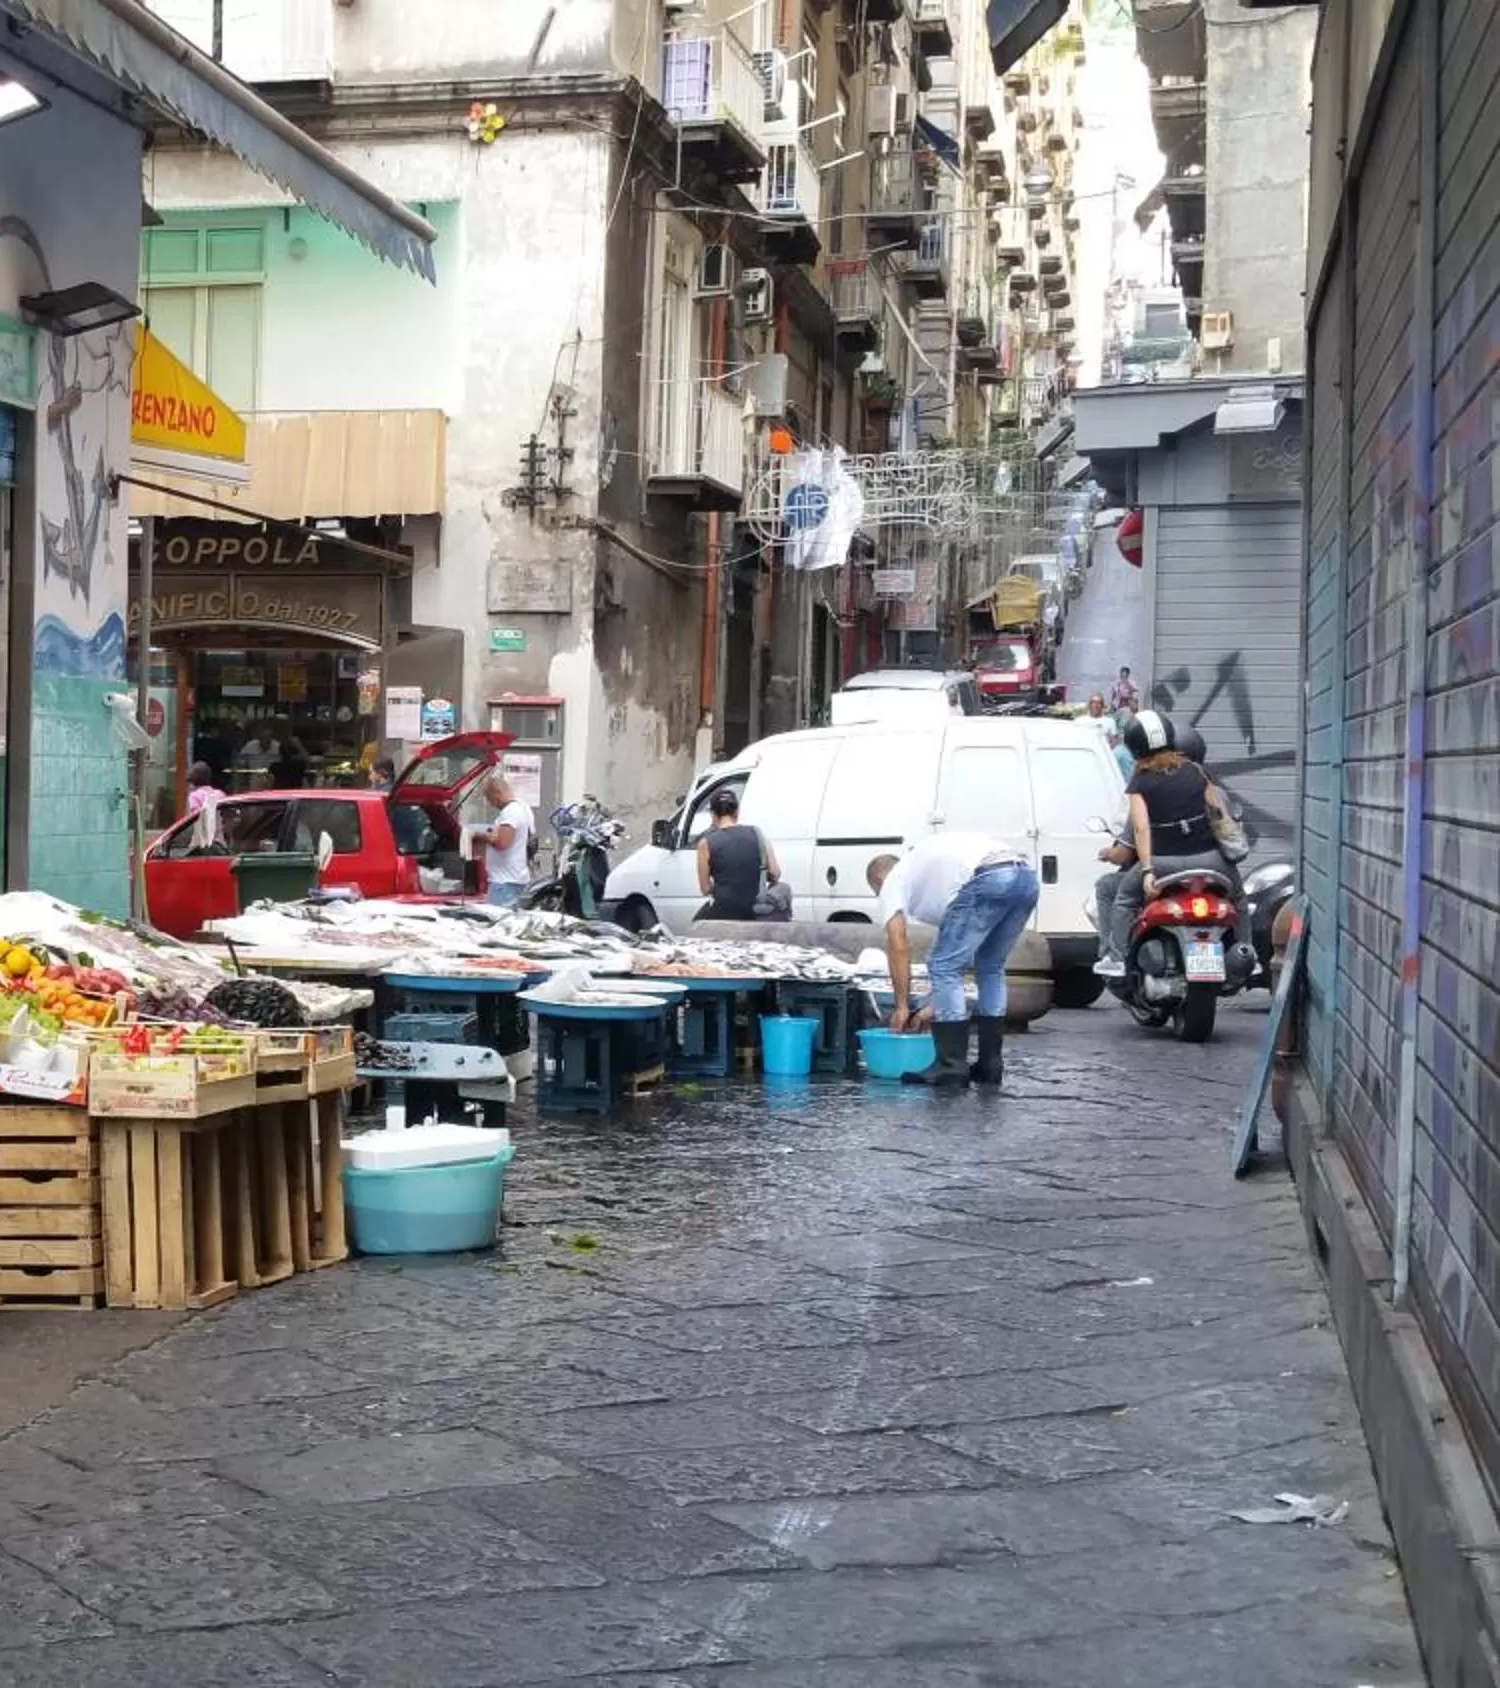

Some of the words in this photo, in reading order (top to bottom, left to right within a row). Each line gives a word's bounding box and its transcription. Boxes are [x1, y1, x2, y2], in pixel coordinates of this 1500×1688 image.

[131, 389, 216, 439] RENZANO
[128, 591, 260, 625] ANIFICO
[306, 604, 357, 629] 1927
